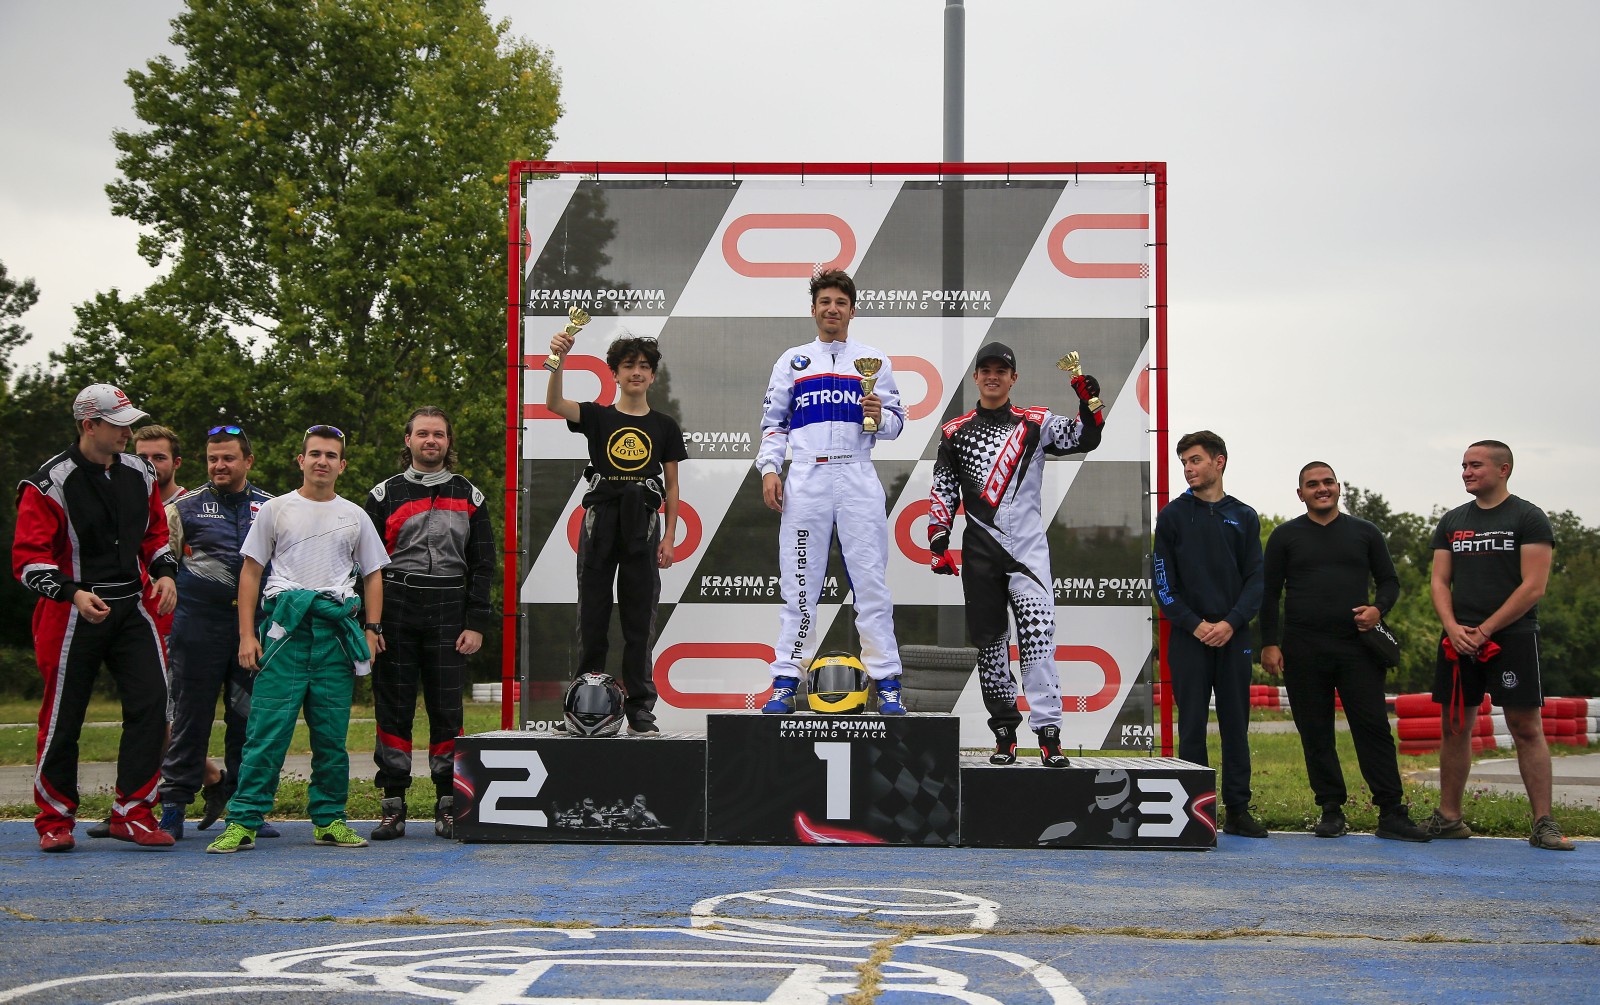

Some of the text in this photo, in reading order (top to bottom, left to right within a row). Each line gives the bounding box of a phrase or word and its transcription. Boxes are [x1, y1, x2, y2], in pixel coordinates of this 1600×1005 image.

[530, 289, 666, 300] KRASNA POLYANA
[855, 290, 992, 301] KRASNA POLYANA
[529, 300, 666, 309] KARTING TRACK
[855, 301, 992, 310] KARTING TRACK
[682, 432, 751, 443] POLYANA
[615, 446, 645, 457] LOTUS
[699, 443, 751, 452] TRACK
[984, 423, 1025, 504] OMP
[1452, 539, 1515, 552] BATTLE
[701, 575, 764, 587] KRASNA
[1052, 577, 1095, 590] ASNA
[700, 587, 775, 596] KARTING
[791, 529, 811, 661] The essence of racing
[1054, 589, 1106, 599] RTING
[780, 720, 886, 731] KRASNA POLYANA
[780, 730, 887, 739] KARTING TRACK
[814, 741, 851, 820] 1
[478, 750, 549, 828] 2
[1137, 778, 1190, 838] 3
